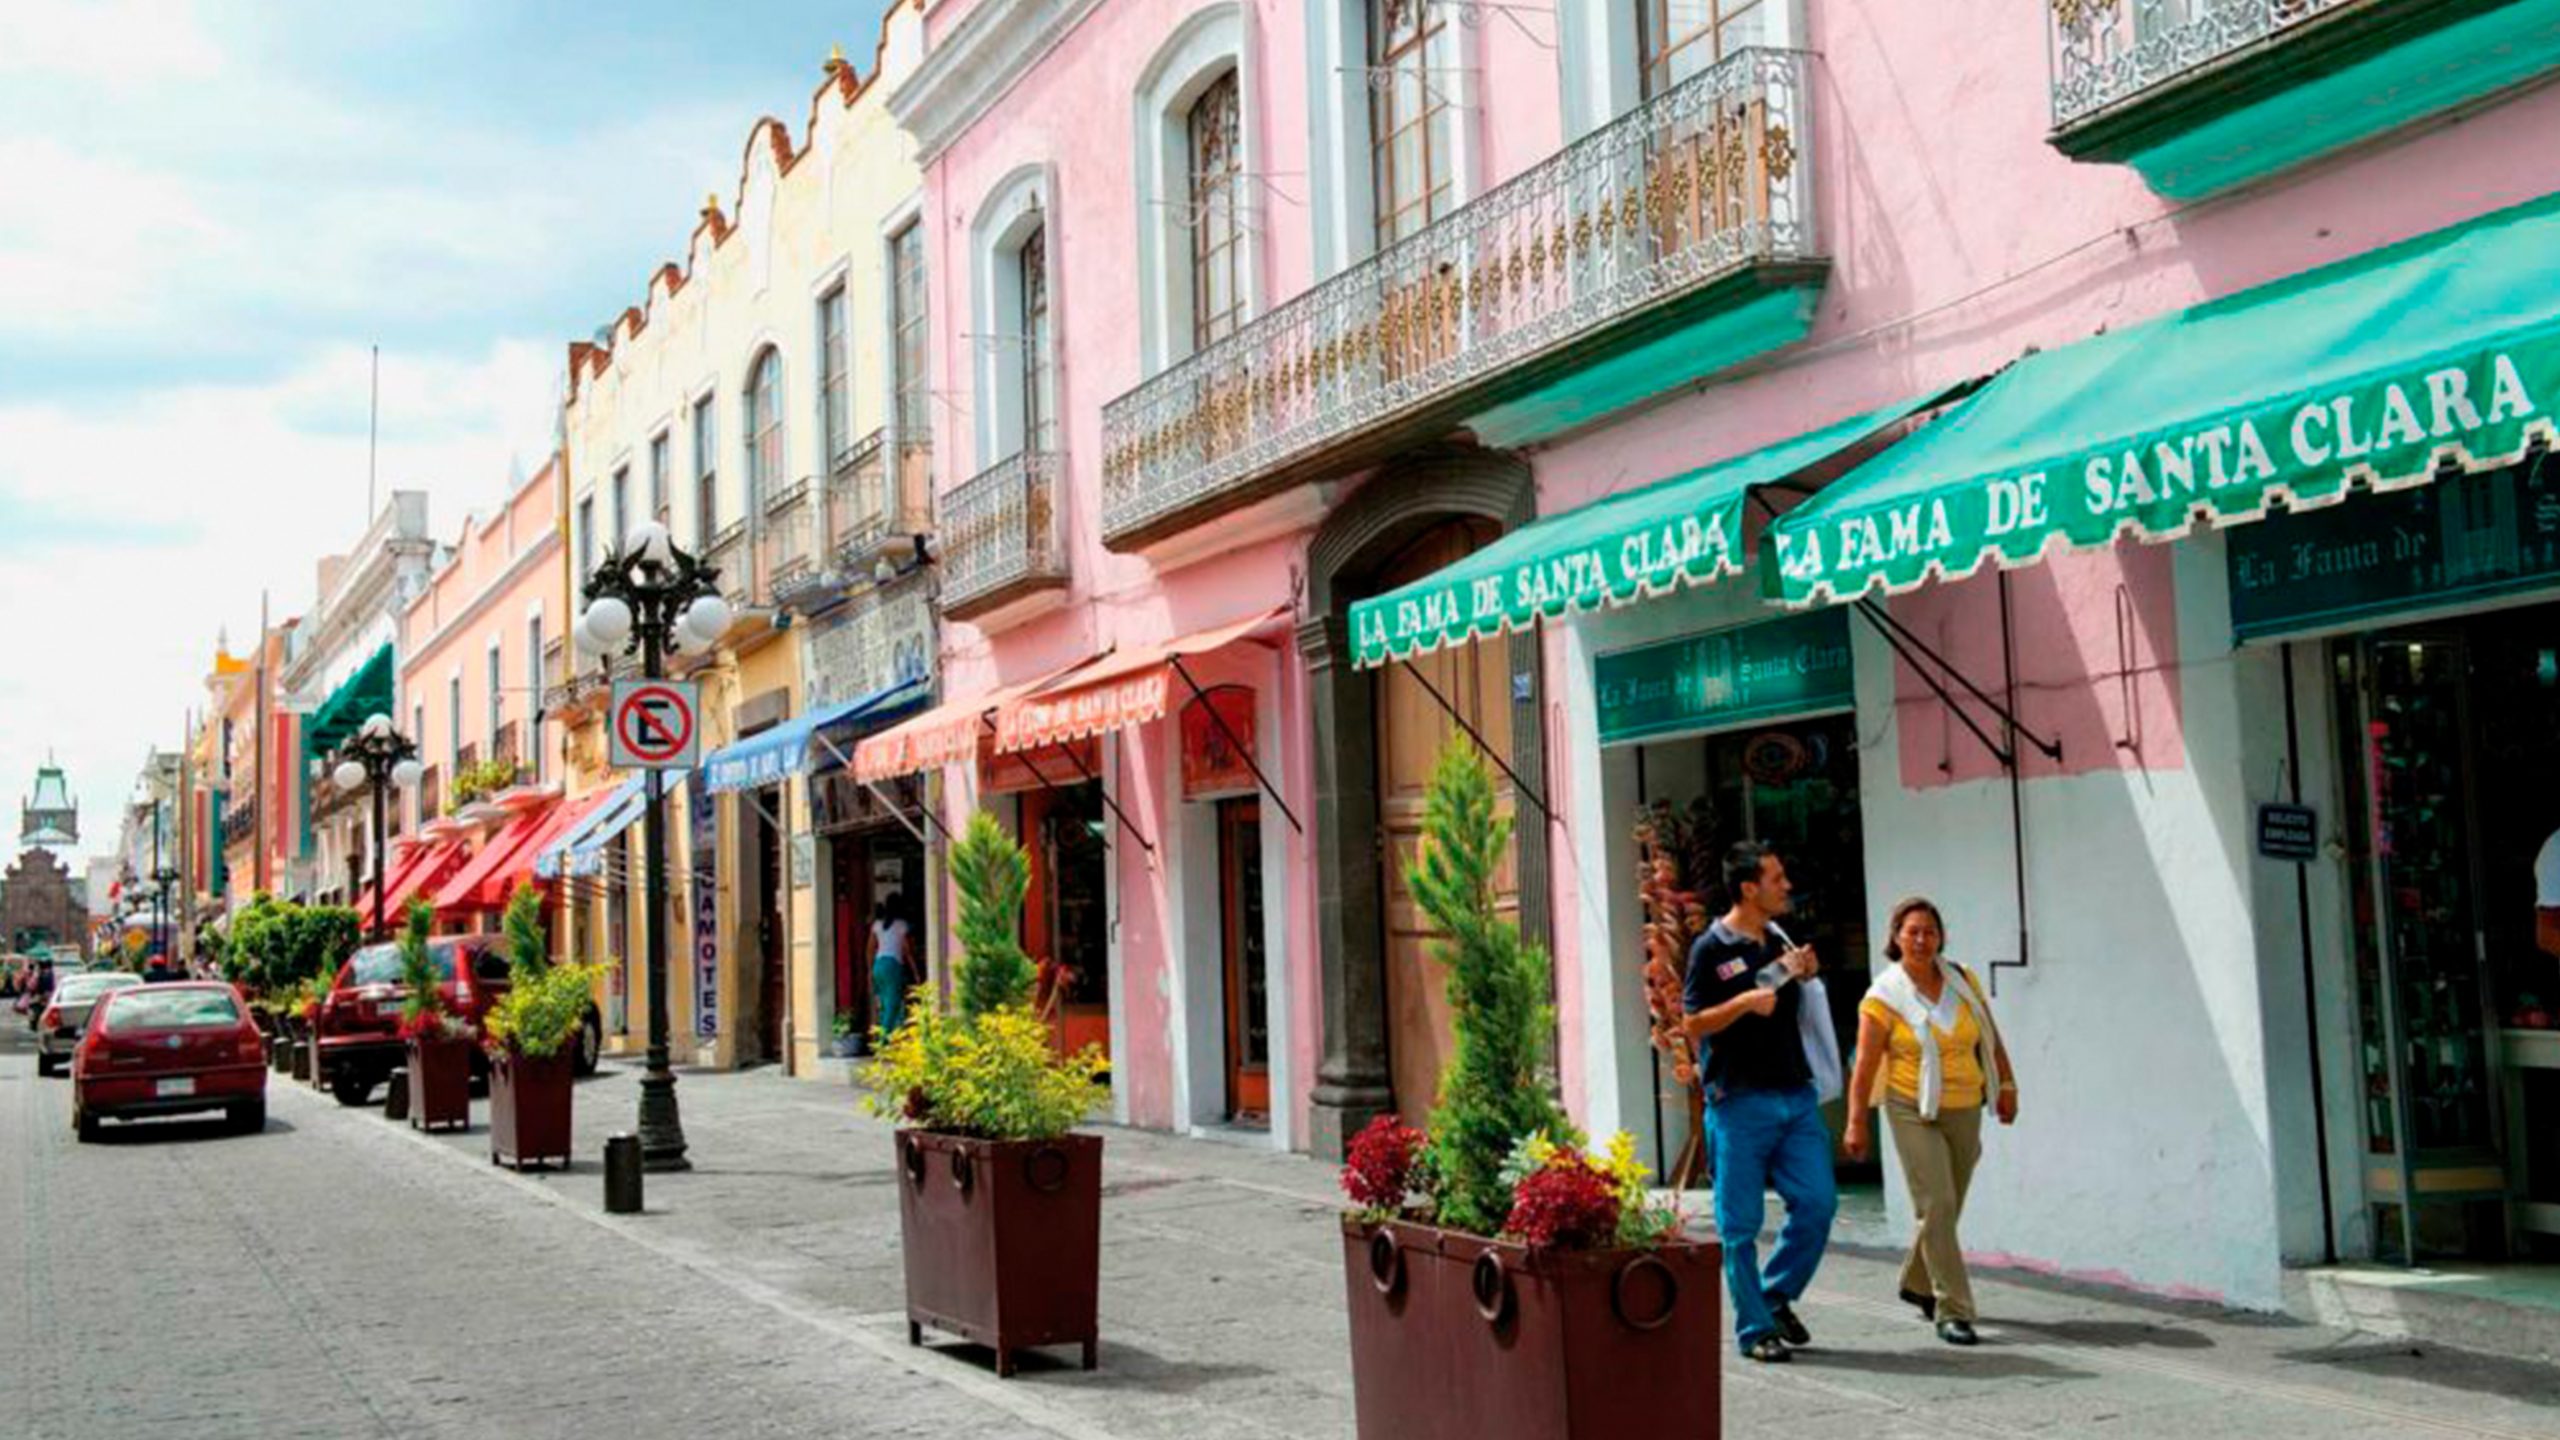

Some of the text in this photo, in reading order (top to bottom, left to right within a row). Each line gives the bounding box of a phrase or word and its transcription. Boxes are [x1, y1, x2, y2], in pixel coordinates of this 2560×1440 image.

[1775, 353, 2534, 580] LA FAMA DE SANTA CLARA
[1358, 512, 1730, 647] LA FAMA DE SANTA CLARA
